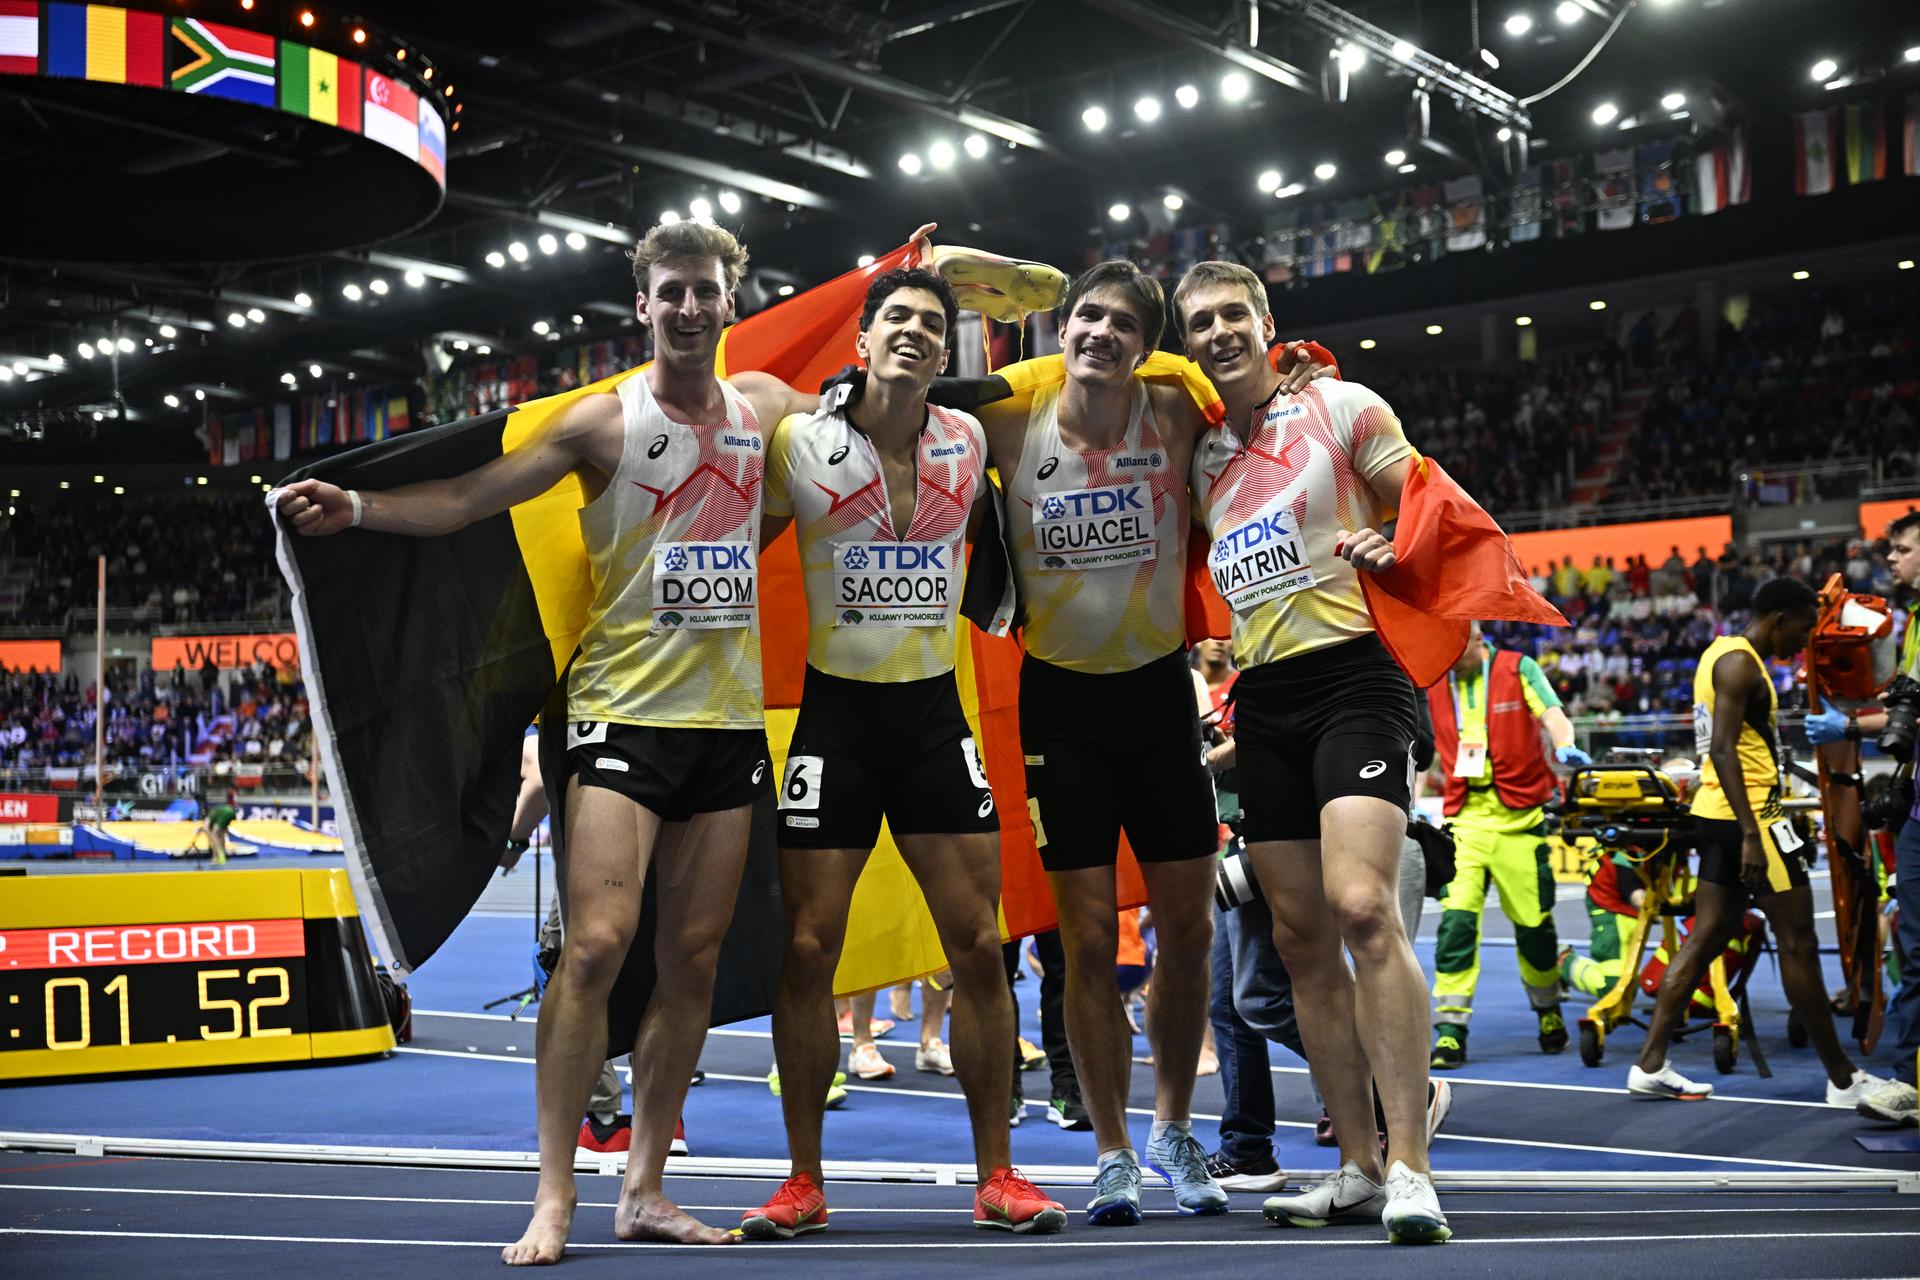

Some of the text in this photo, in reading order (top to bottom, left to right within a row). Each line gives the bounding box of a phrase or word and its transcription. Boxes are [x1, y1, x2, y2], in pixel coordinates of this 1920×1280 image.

[724, 435, 750, 447] Allianz
[931, 446, 955, 458] Allianz
[1116, 457, 1148, 468] Allianz
[1064, 486, 1144, 516] TDK
[1041, 517, 1149, 550] IGUACEL
[1227, 511, 1290, 555] TDK
[688, 545, 752, 570] TDK
[869, 546, 946, 570] TDK
[1071, 547, 1151, 565] KUJAWY POMORZE 26
[1214, 540, 1300, 594] WATRIN
[662, 576, 753, 604] DOOM
[841, 576, 948, 603] SACOOR
[1234, 588, 1260, 605] KUJAWY
[1261, 577, 1297, 596] POMORZE
[689, 615, 722, 623] KUJAWY
[869, 613, 902, 622] KUJAWY
[904, 612, 939, 621] POMORZE
[787, 763, 808, 801] 6
[1783, 824, 1795, 844] 1
[48, 923, 257, 964] RECORD
